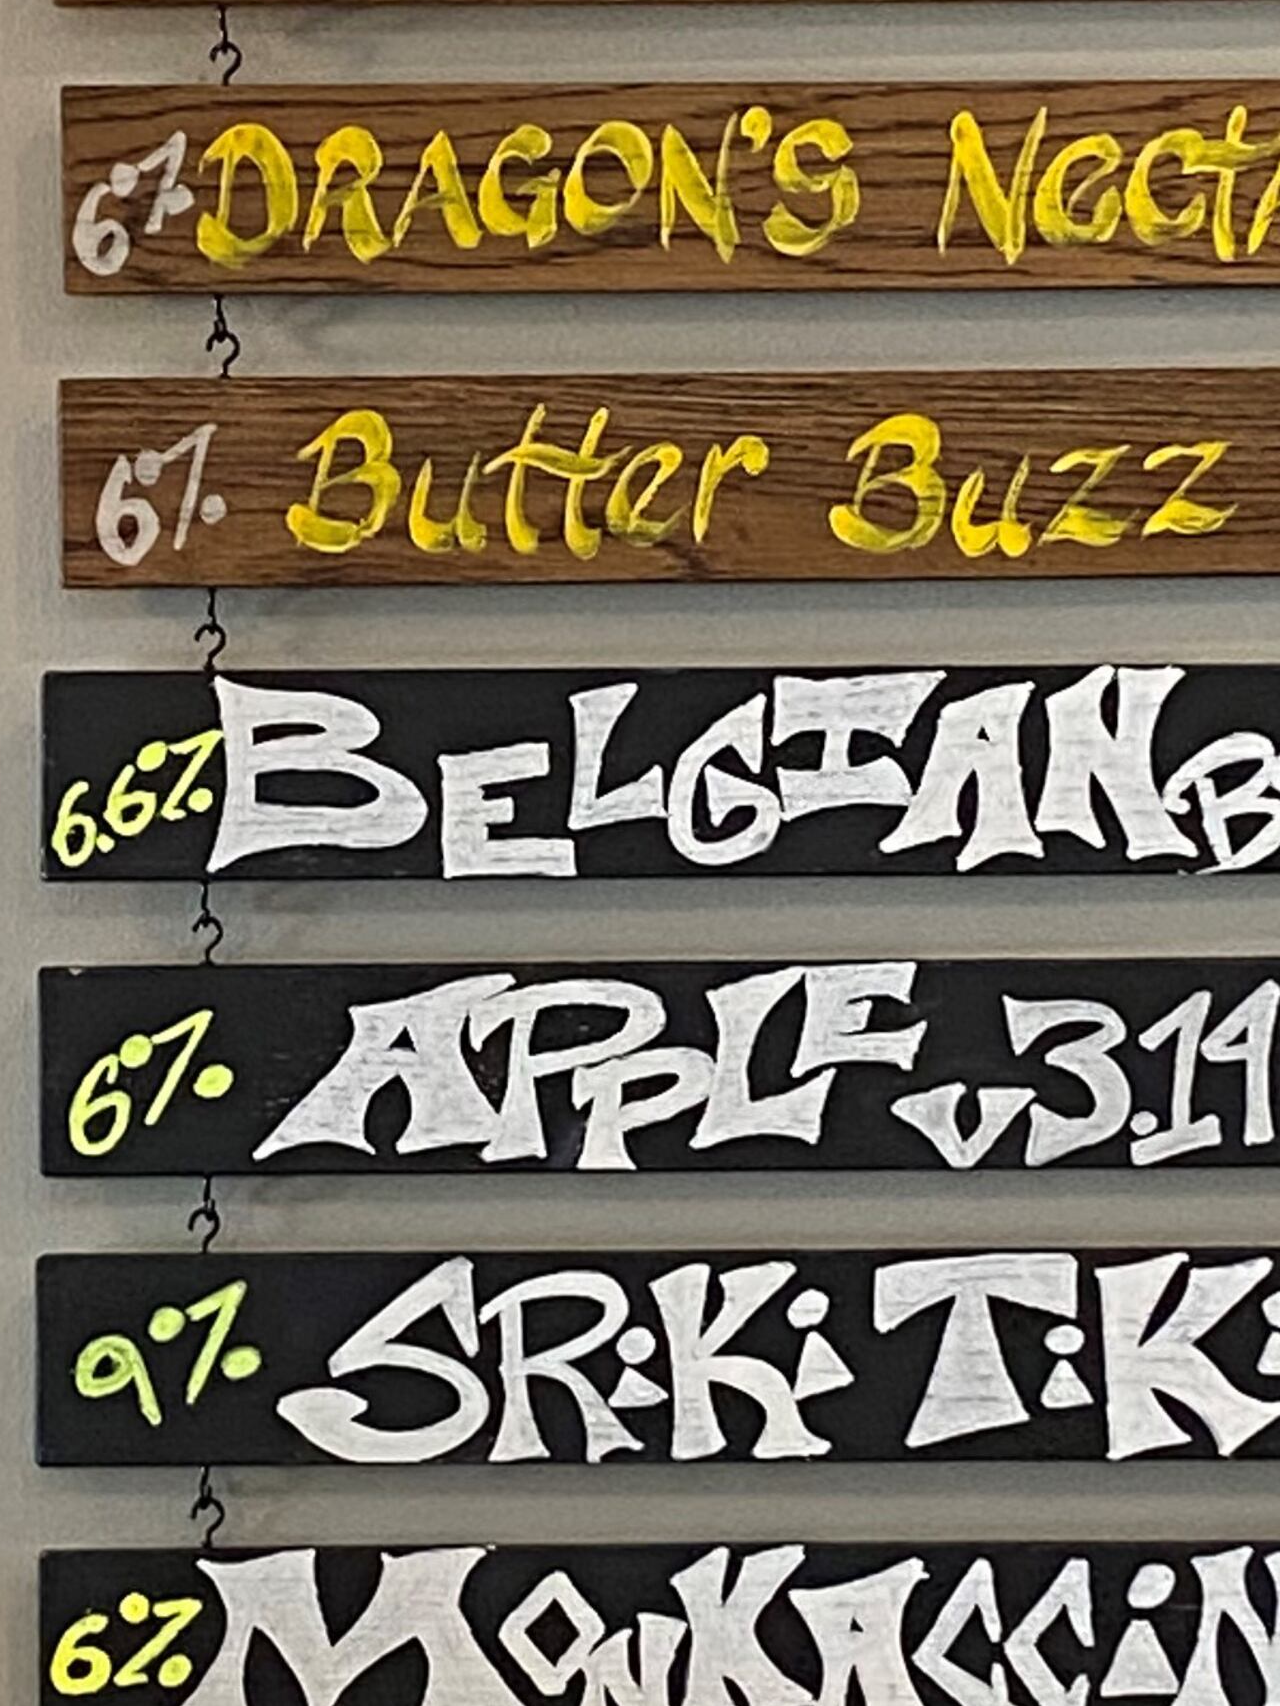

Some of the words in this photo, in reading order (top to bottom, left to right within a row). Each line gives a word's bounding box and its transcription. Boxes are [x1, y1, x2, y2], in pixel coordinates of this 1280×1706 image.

[71, 130, 194, 278] 6%
[194, 105, 863, 268] DRAGON'S
[94, 422, 228, 567] 6%
[284, 403, 771, 560] Butter
[826, 411, 1240, 560] Buzz
[50, 729, 222, 869] 6.6%
[206, 664, 1198, 881] BELGIAN
[68, 1011, 233, 1159] 6%
[252, 959, 928, 1171] APPLE
[73, 1281, 262, 1427] 9%
[49, 1592, 202, 1695] 6%
